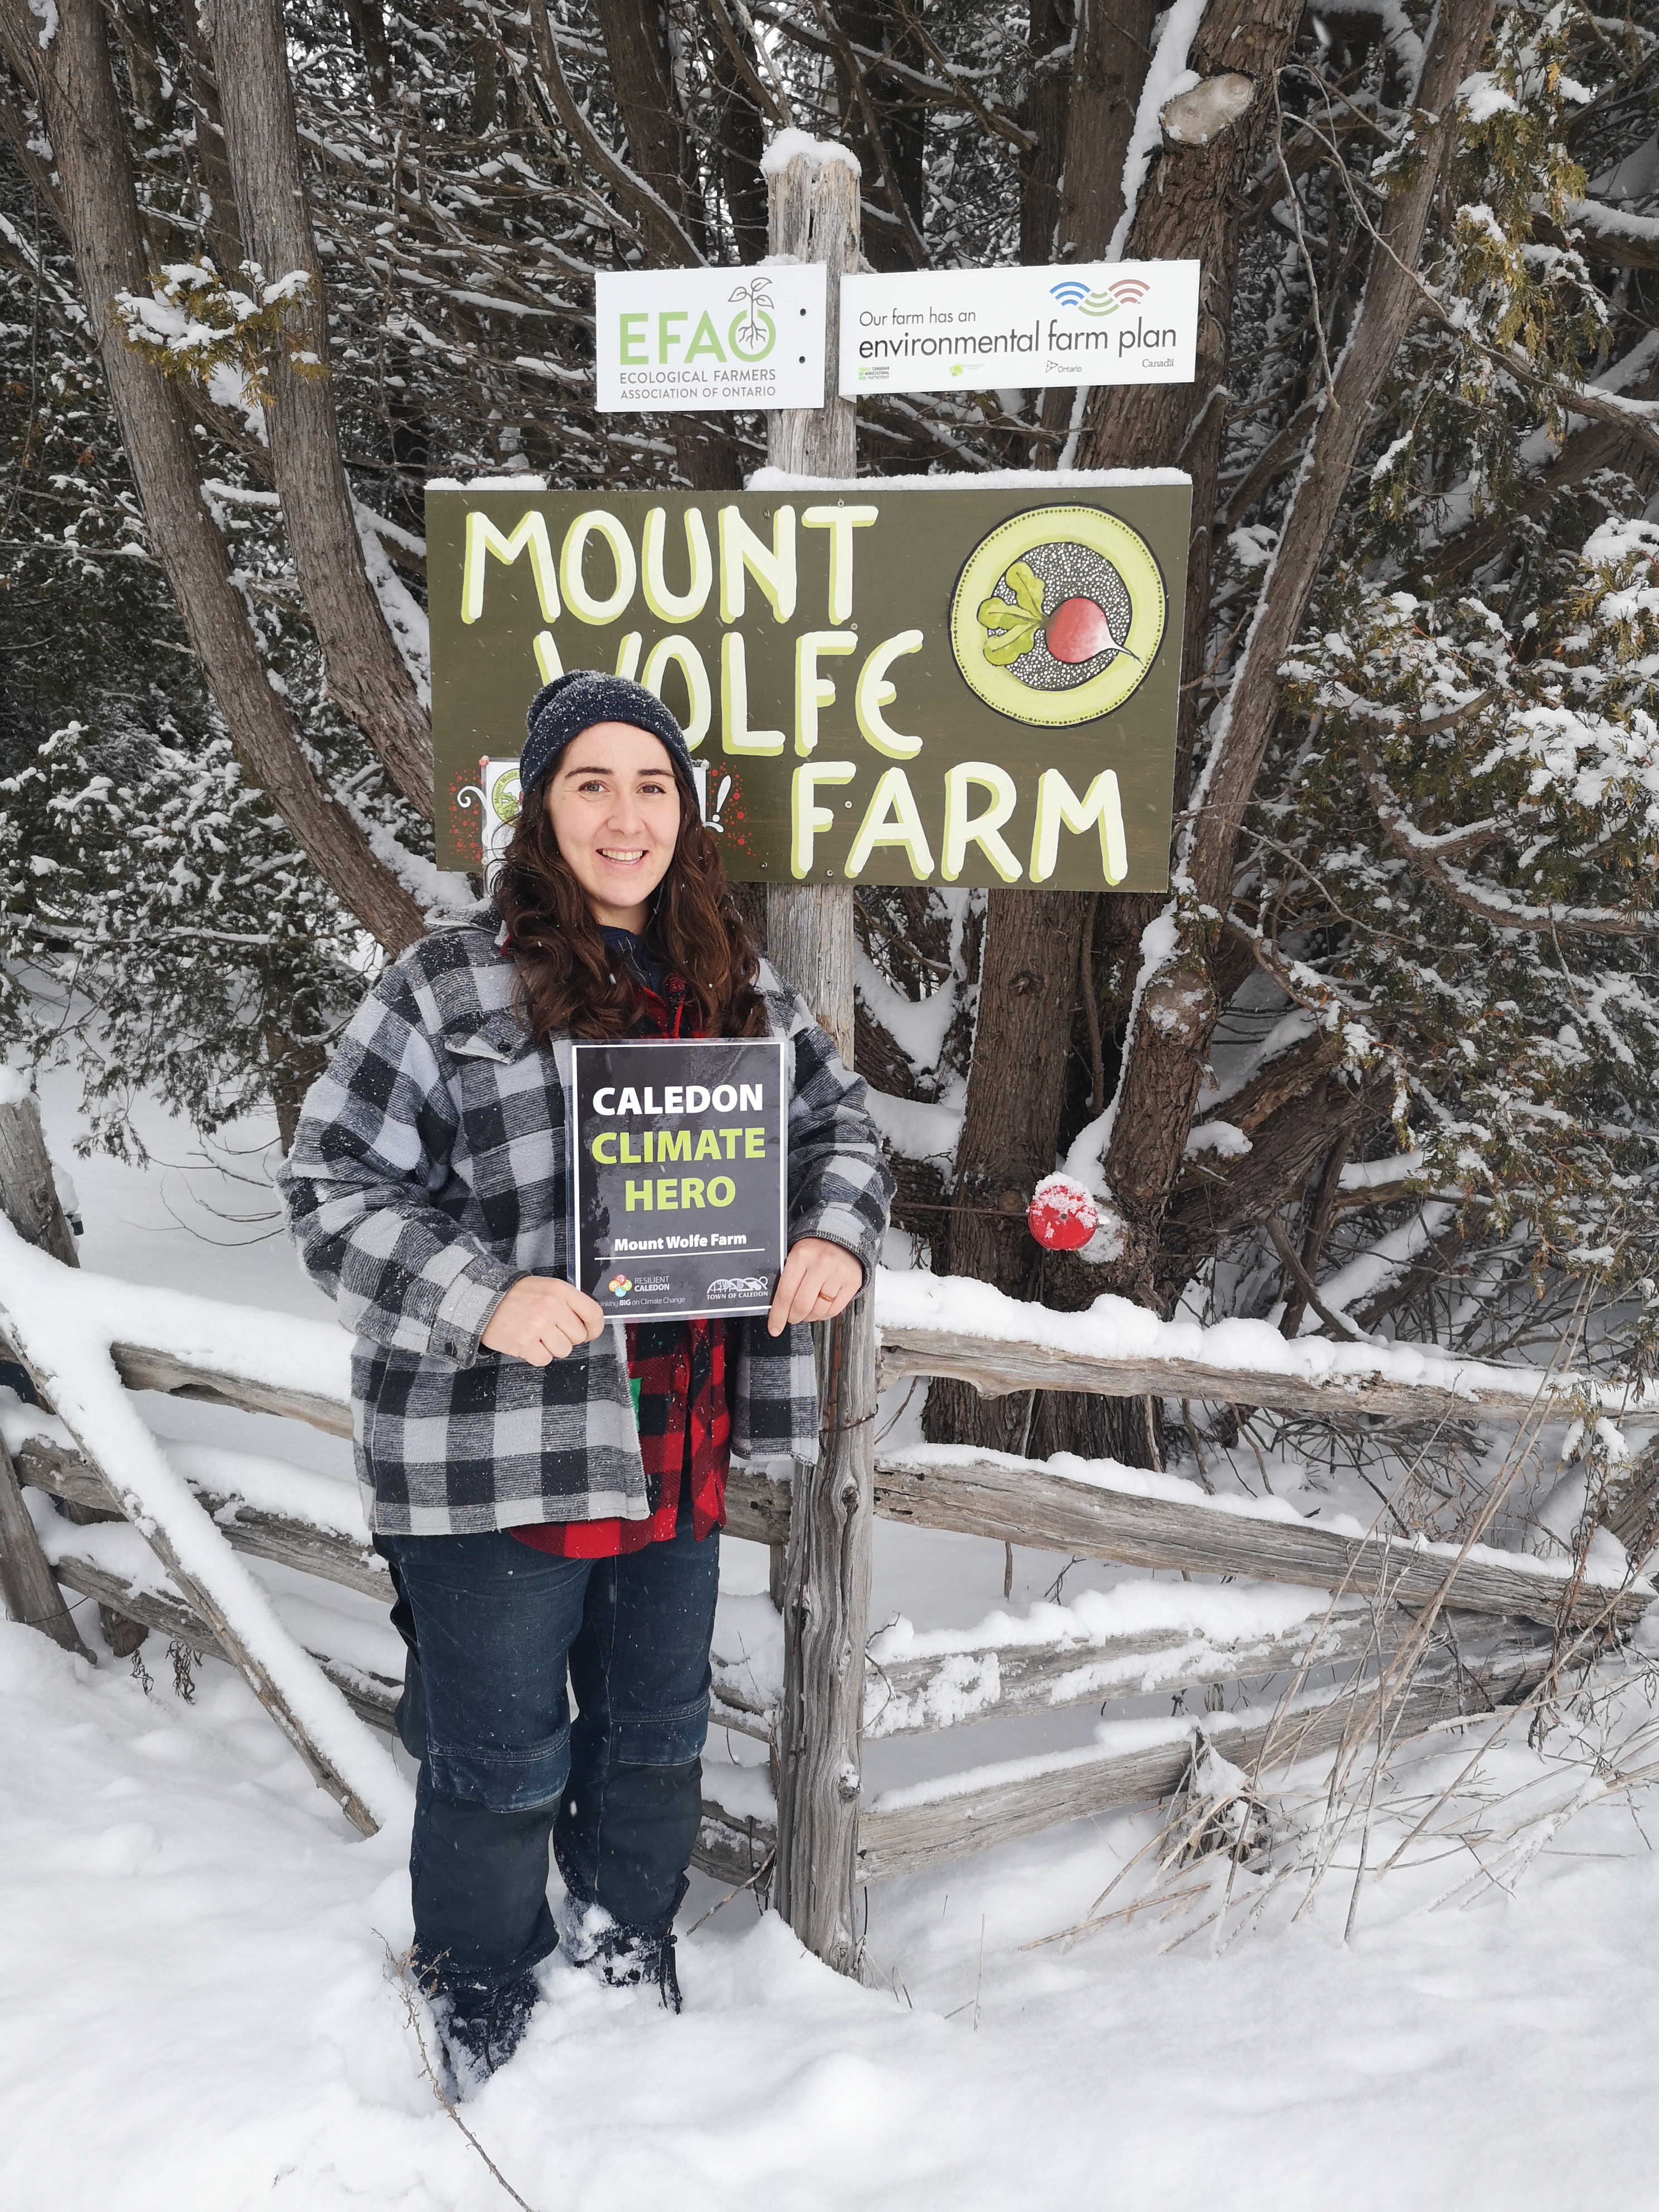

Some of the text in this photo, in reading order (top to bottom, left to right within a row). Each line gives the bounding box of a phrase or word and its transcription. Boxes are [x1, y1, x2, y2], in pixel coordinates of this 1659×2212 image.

[859, 306, 976, 327] Our farm has an
[620, 309, 776, 365] EFAO
[858, 317, 1177, 358] environmental farm plan
[1142, 358, 1174, 367] Canada
[620, 369, 776, 384] ECOLOGICAL FARMERS
[620, 386, 776, 400] ASSOCIATION OF ONTARIO
[462, 506, 878, 625] MOUNT
[501, 772, 517, 783] Wolfe
[791, 761, 1128, 886] FARM
[593, 1084, 763, 1115] CALEDON
[591, 1127, 766, 1164] CLIMATE
[625, 1176, 736, 1212] HERO
[614, 1234, 747, 1251] Mount Wolfe Farm
[634, 1276, 670, 1284] RESILIENT
[663, 1296, 686, 1305] Change
